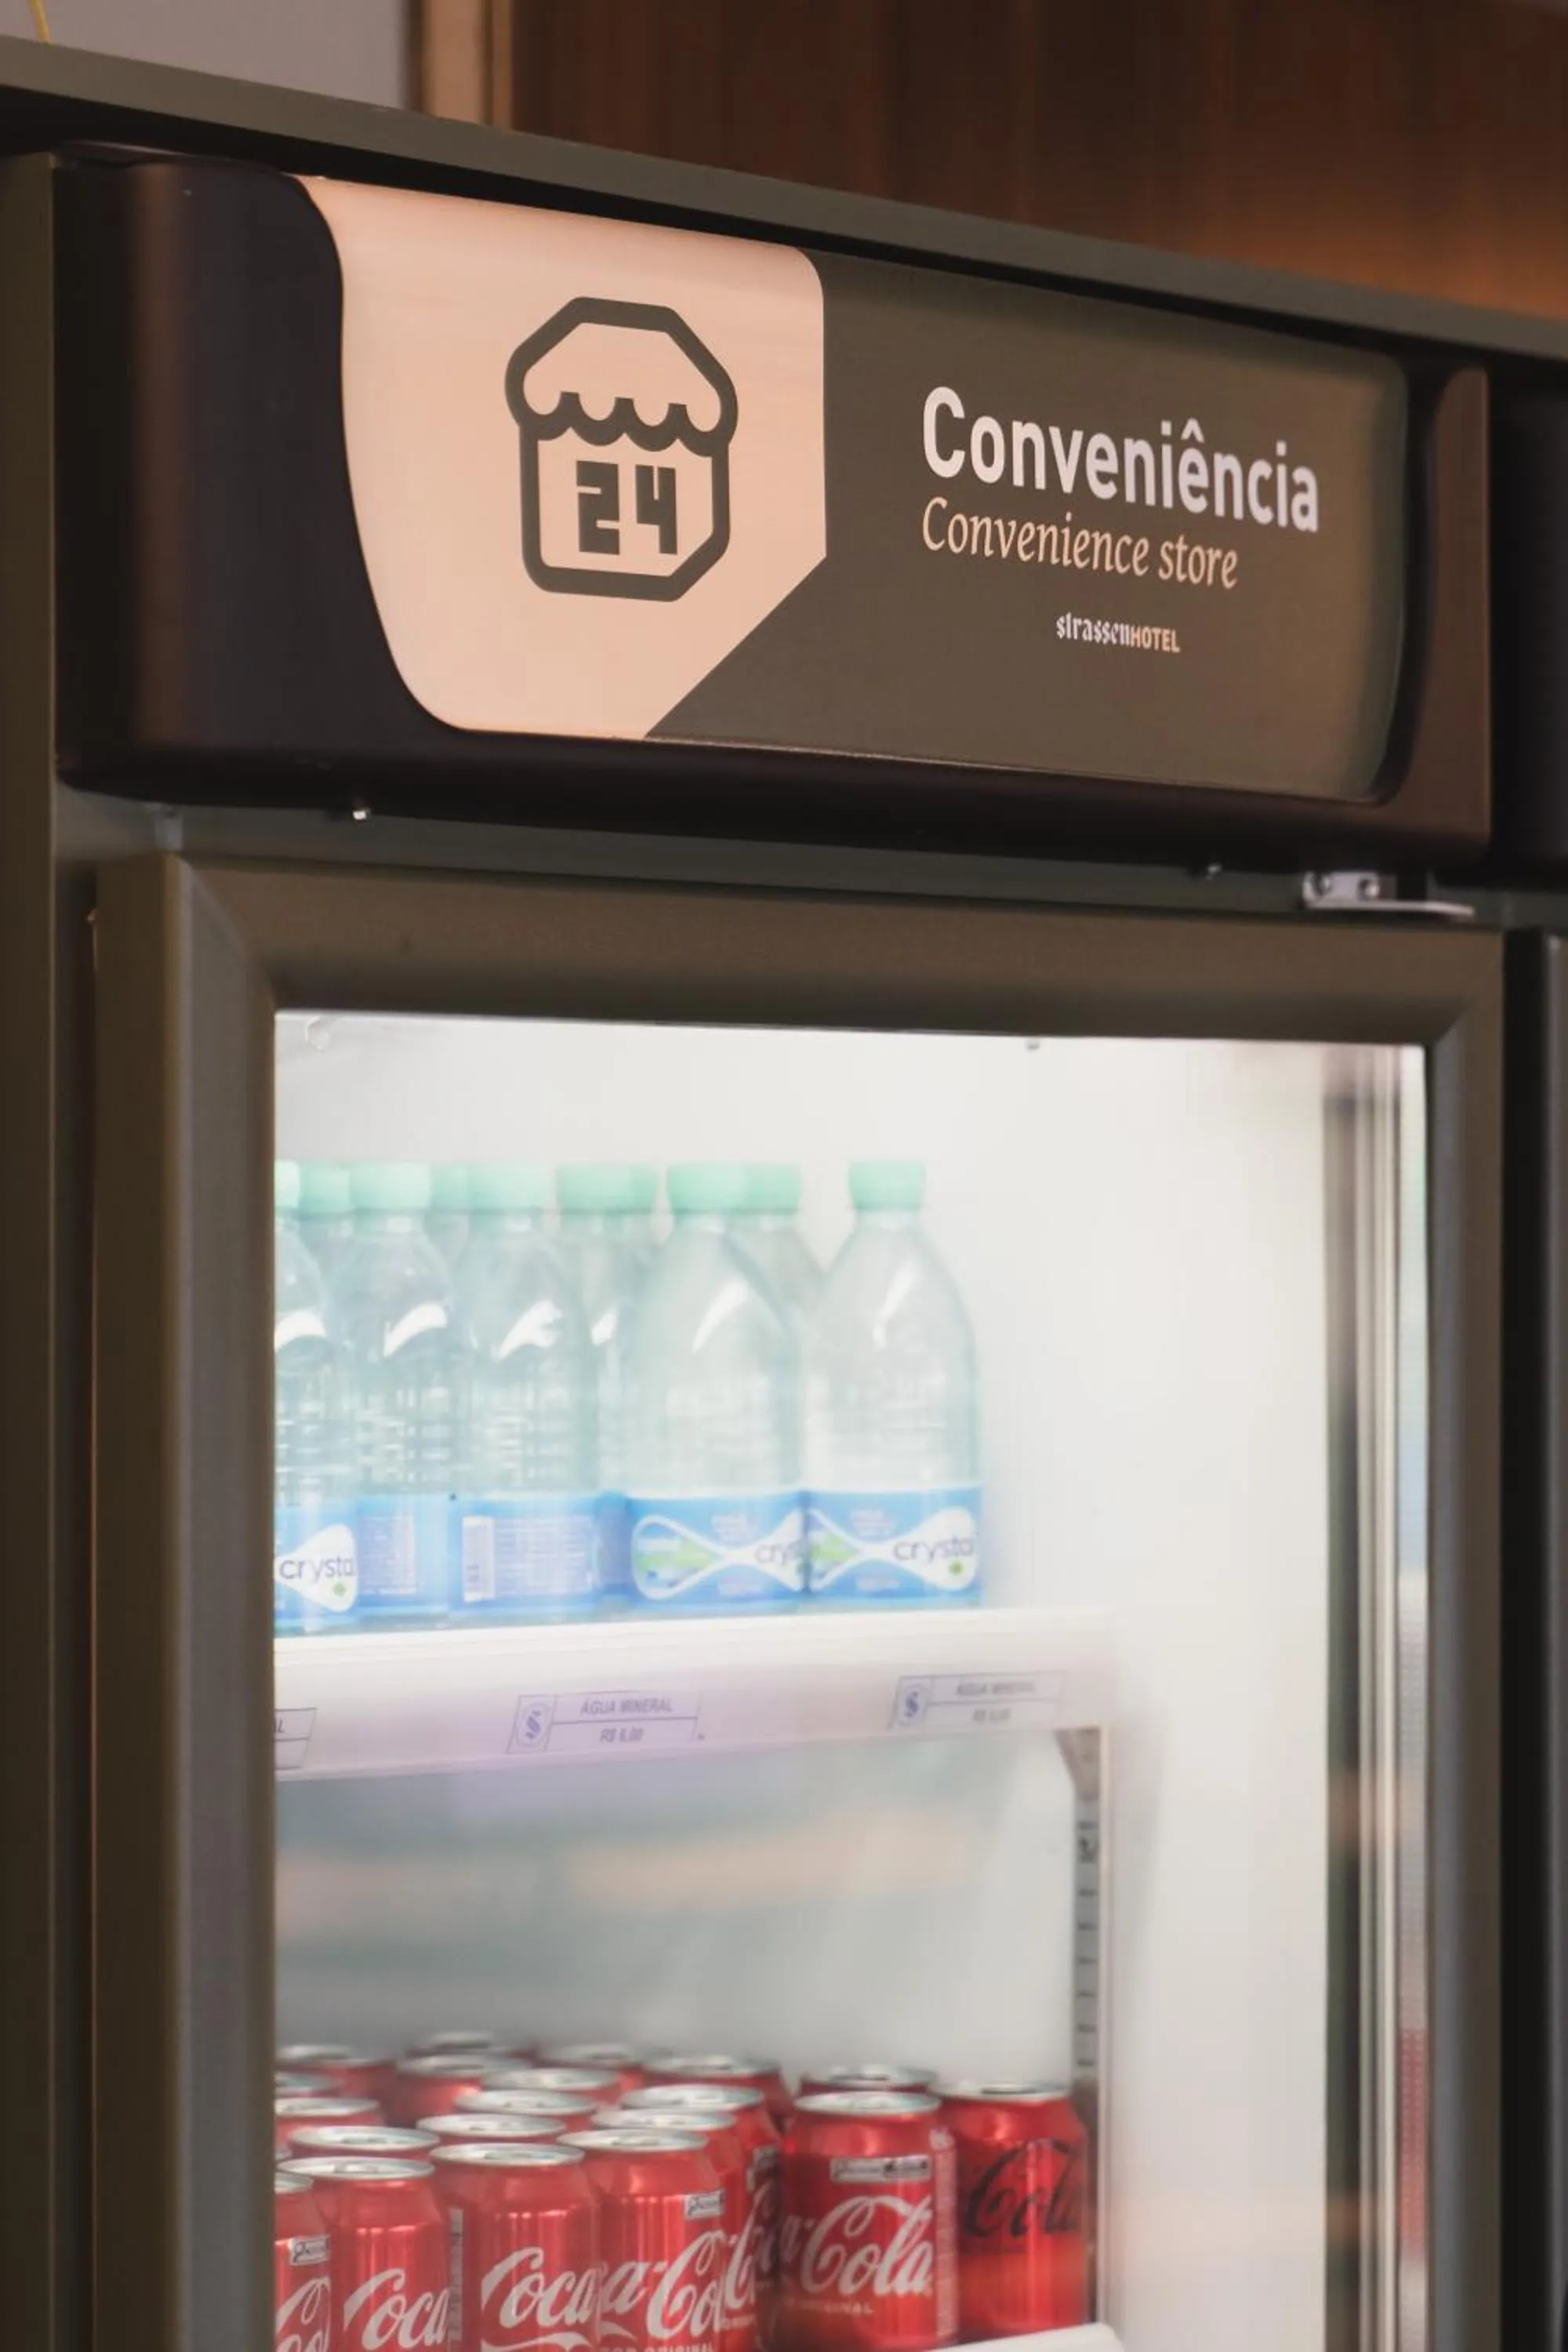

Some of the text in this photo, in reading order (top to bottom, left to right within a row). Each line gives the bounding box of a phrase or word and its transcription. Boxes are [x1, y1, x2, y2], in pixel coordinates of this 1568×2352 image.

[576, 459, 677, 555] 24
[923, 386, 1319, 533] Conveniência
[922, 497, 1239, 589] Convenience store
